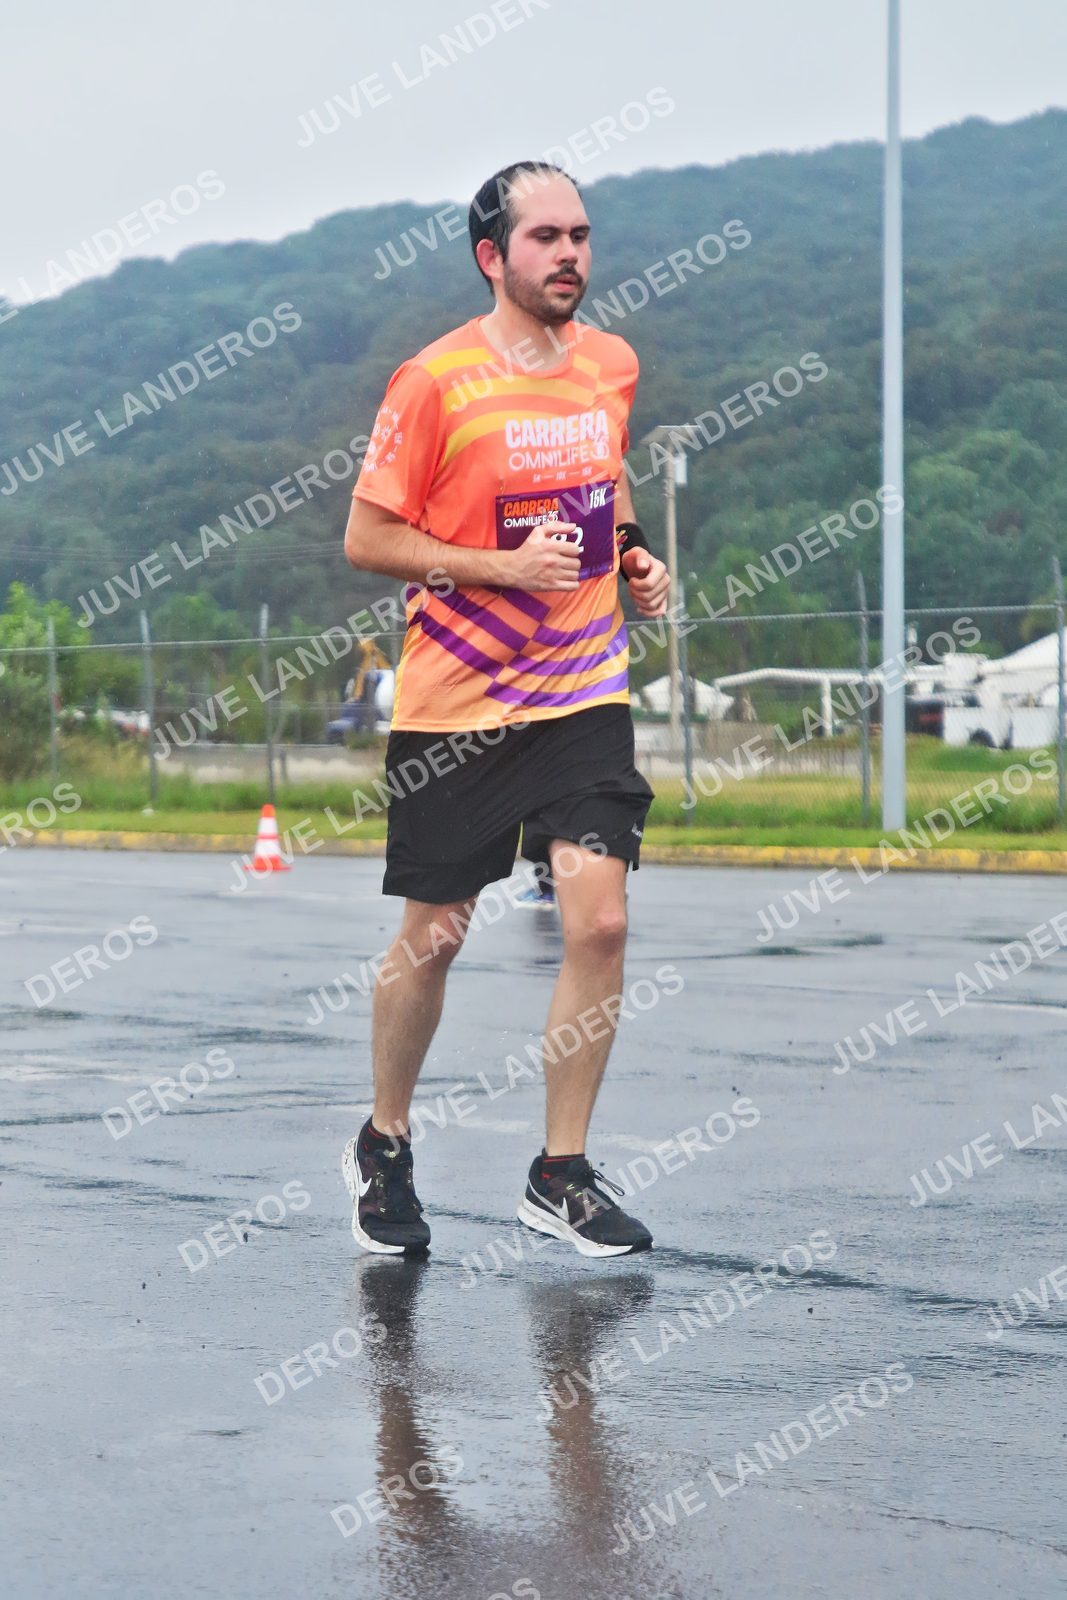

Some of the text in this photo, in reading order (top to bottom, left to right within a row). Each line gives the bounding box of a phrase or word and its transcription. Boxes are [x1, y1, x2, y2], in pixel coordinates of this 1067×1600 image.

[505, 410, 609, 448] CARRERA
[508, 445, 589, 471] OMNILIFE
[503, 497, 559, 518] CARRERA
[589, 488, 607, 509] 15K
[504, 515, 548, 528] OMNILIFE
